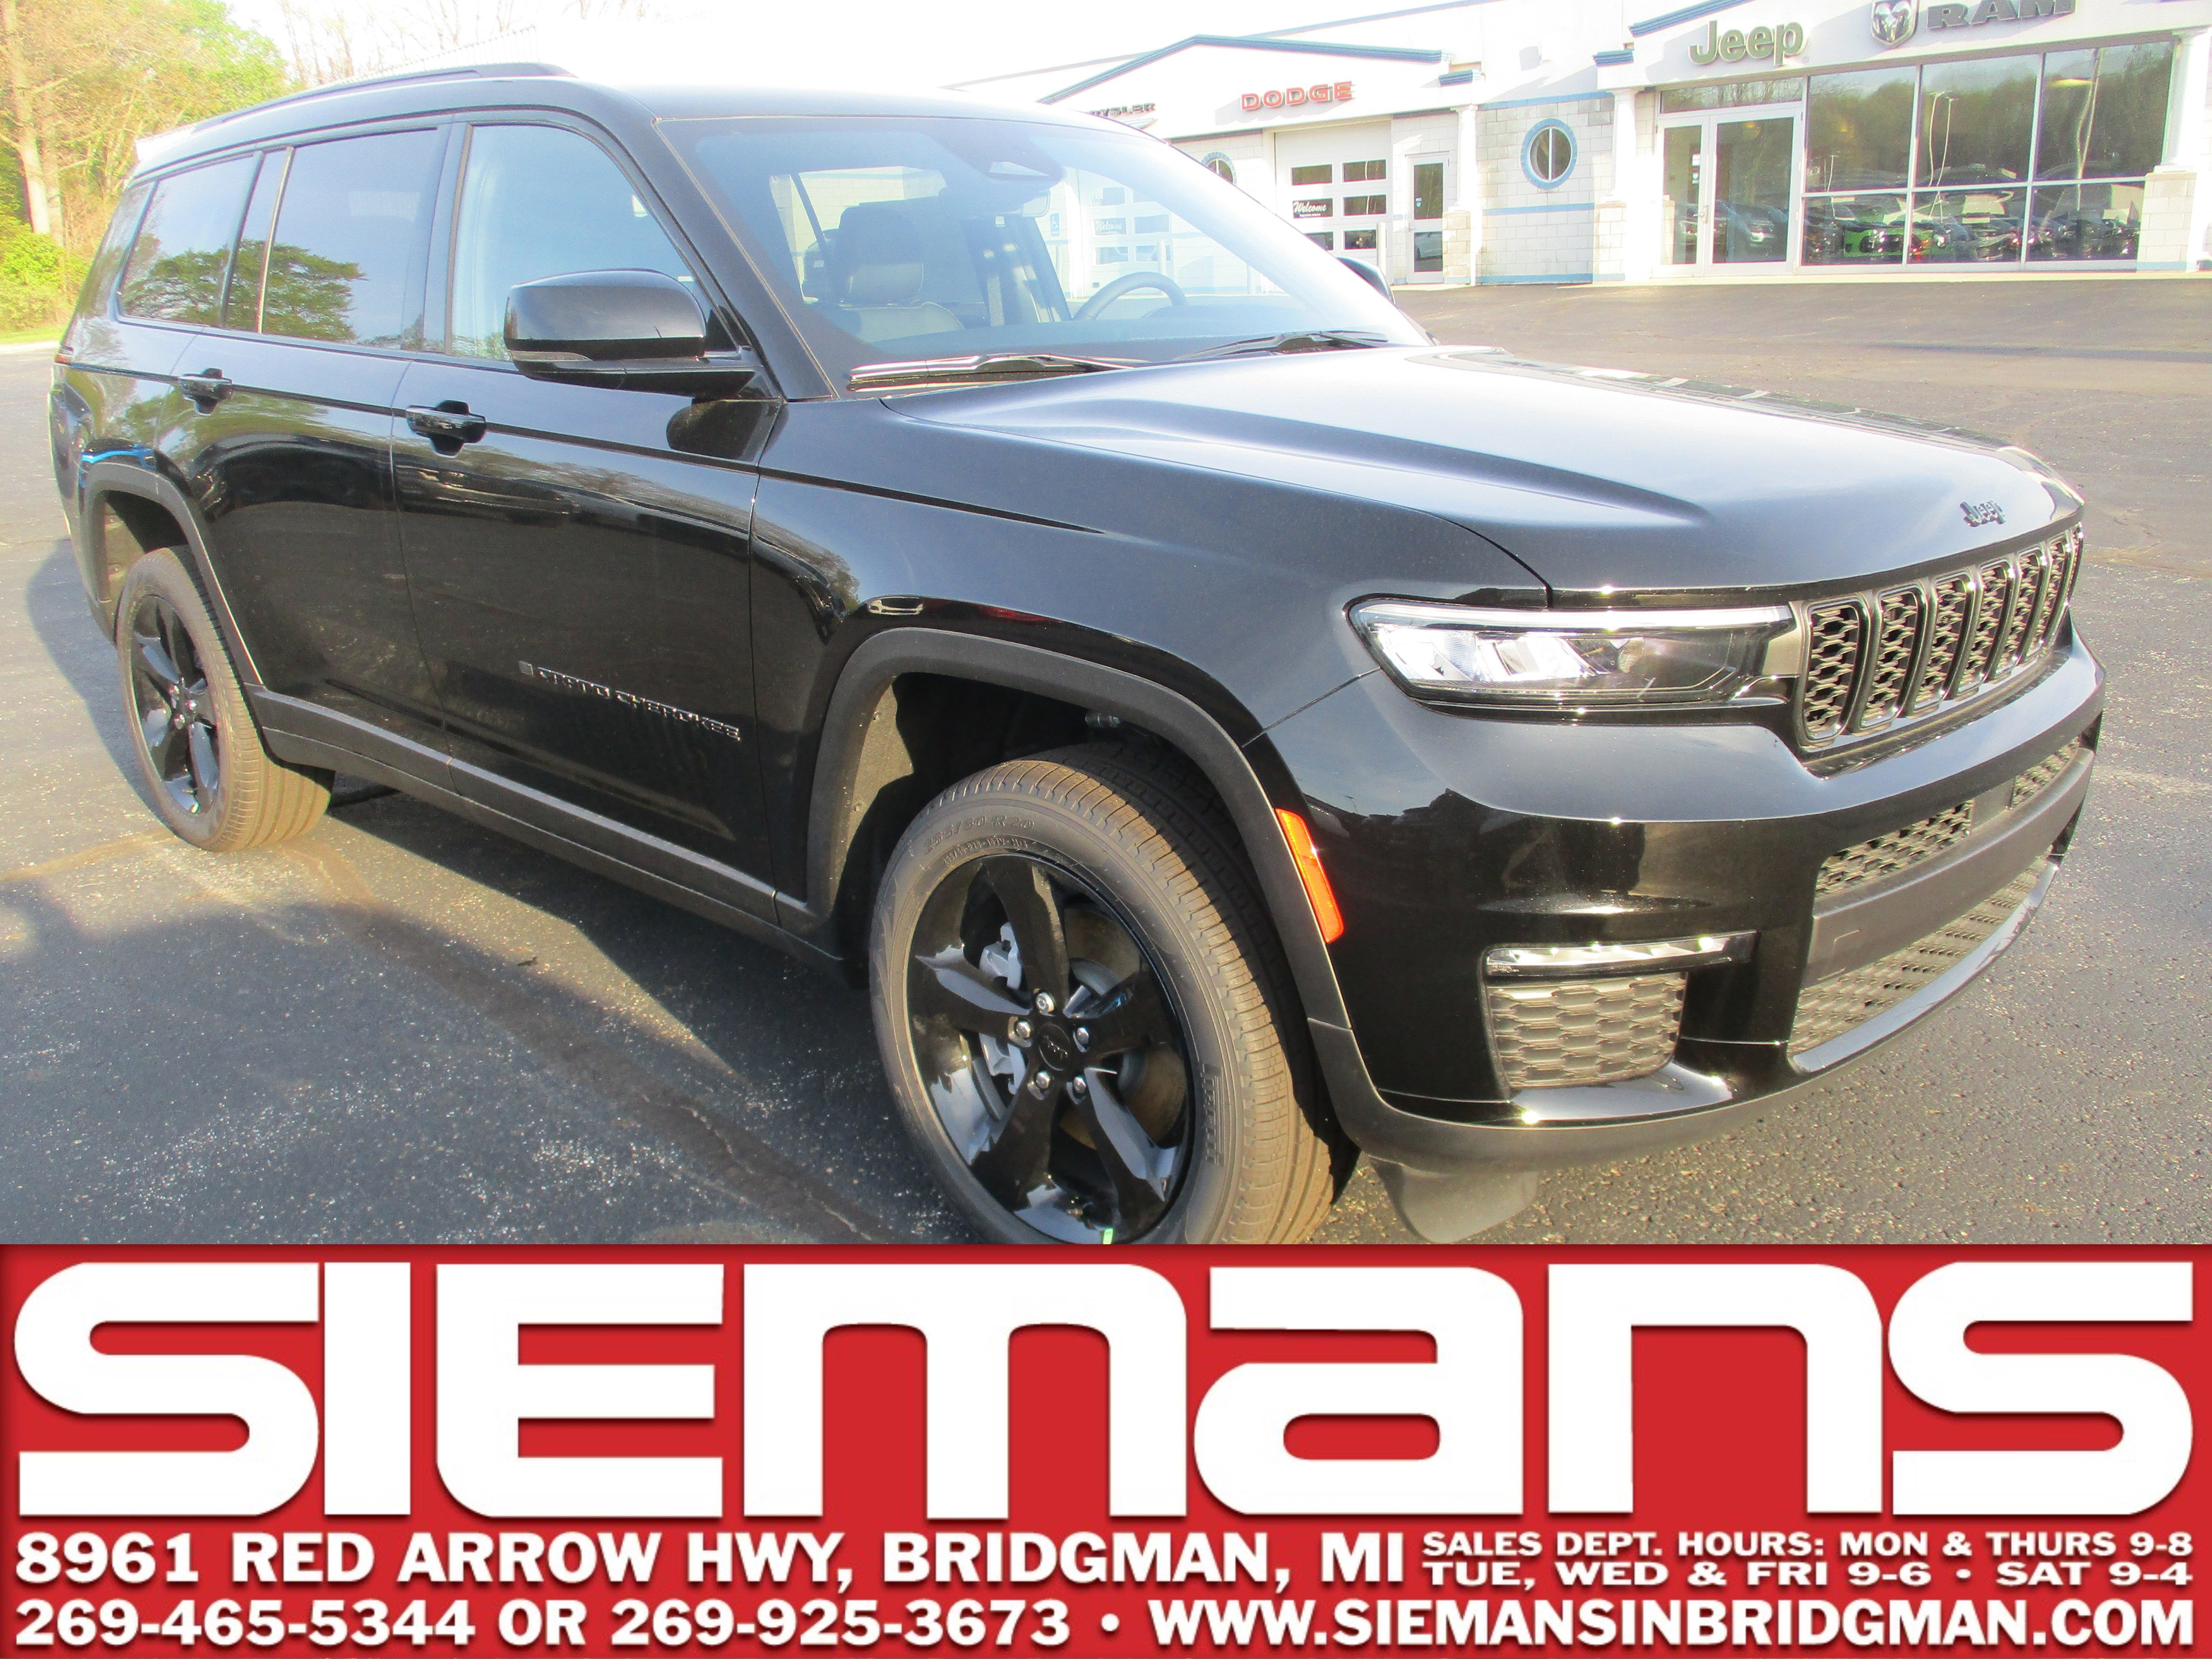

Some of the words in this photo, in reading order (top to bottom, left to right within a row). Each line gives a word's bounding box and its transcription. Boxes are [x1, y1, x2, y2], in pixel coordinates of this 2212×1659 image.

[1926, 0, 2075, 29] RAM
[1688, 20, 1804, 65] Jeep
[1240, 81, 1352, 110] DODGE
[1293, 201, 1327, 213] Welcome
[1096, 220, 1122, 231] Welcome
[1960, 500, 2007, 527] Jeep
